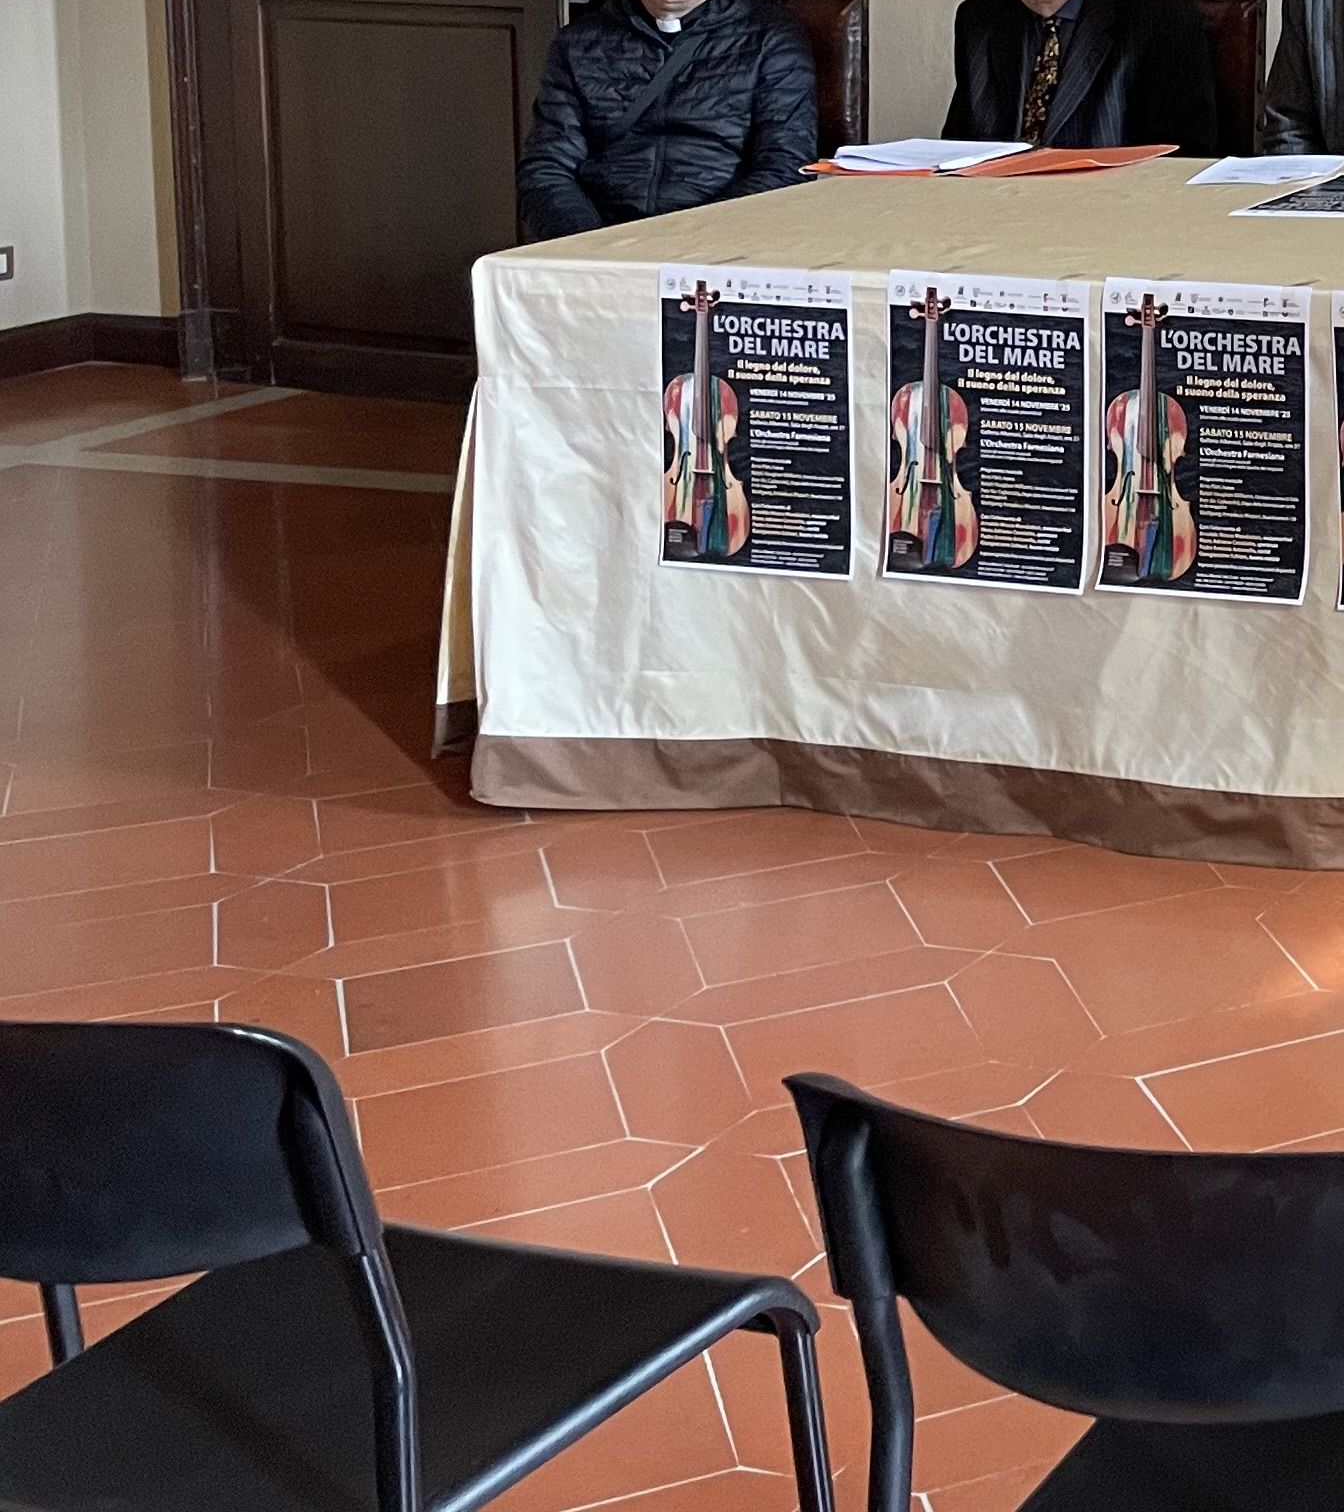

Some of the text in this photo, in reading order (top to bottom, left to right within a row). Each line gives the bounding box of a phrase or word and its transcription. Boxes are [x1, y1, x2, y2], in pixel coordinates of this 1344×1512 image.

[714, 315, 844, 340] L'ORCHESTRA
[944, 323, 1081, 350] L'ORCHESTRA
[729, 336, 829, 359] DEL MARE
[1161, 330, 1301, 356] L'ORCHESTRA
[959, 344, 1065, 369] DEL MARE
[1177, 351, 1285, 375] DEL MARE
[1195, 377, 1222, 389] legno
[1224, 378, 1239, 388] del
[1185, 388, 1214, 397] suono
[1216, 388, 1239, 399] della
[1242, 392, 1285, 403] speranza
